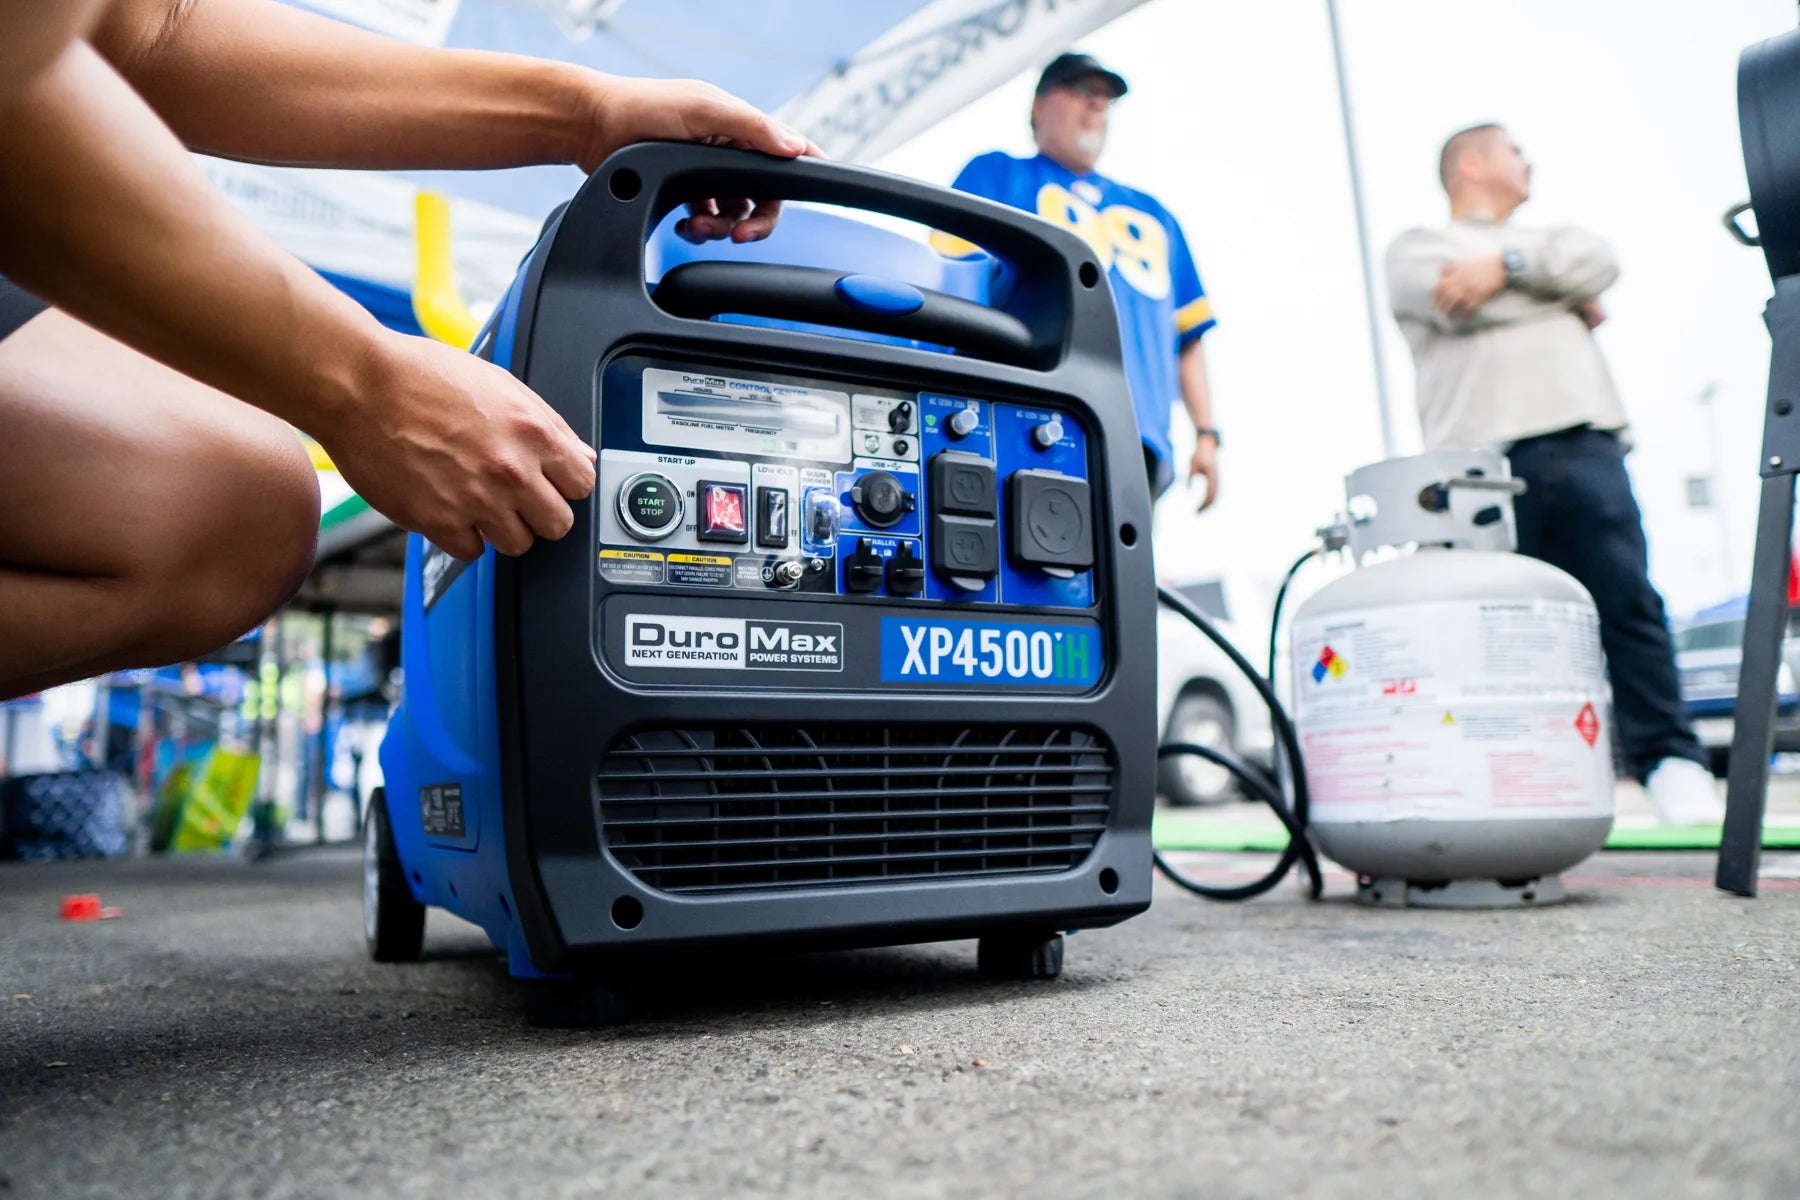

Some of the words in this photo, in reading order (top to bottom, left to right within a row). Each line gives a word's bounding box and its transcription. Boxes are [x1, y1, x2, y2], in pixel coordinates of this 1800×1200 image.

[729, 382, 772, 393] CONTROL
[671, 420, 699, 428] GASOLINE
[657, 456, 682, 465] START
[684, 458, 696, 466] UP
[757, 466, 775, 474] LOW
[686, 490, 695, 498] ON
[637, 498, 665, 506] START
[640, 508, 663, 516] STOP
[685, 524, 697, 532] OFF
[623, 552, 650, 560] CAUTION
[632, 622, 739, 649] Duro
[750, 626, 837, 652] Max
[632, 649, 662, 659] NEXT
[666, 650, 738, 661] GENERATION
[900, 625, 1089, 679] XP4500iH
[750, 653, 788, 663] POWER
[790, 654, 838, 664] SYSTEMS
